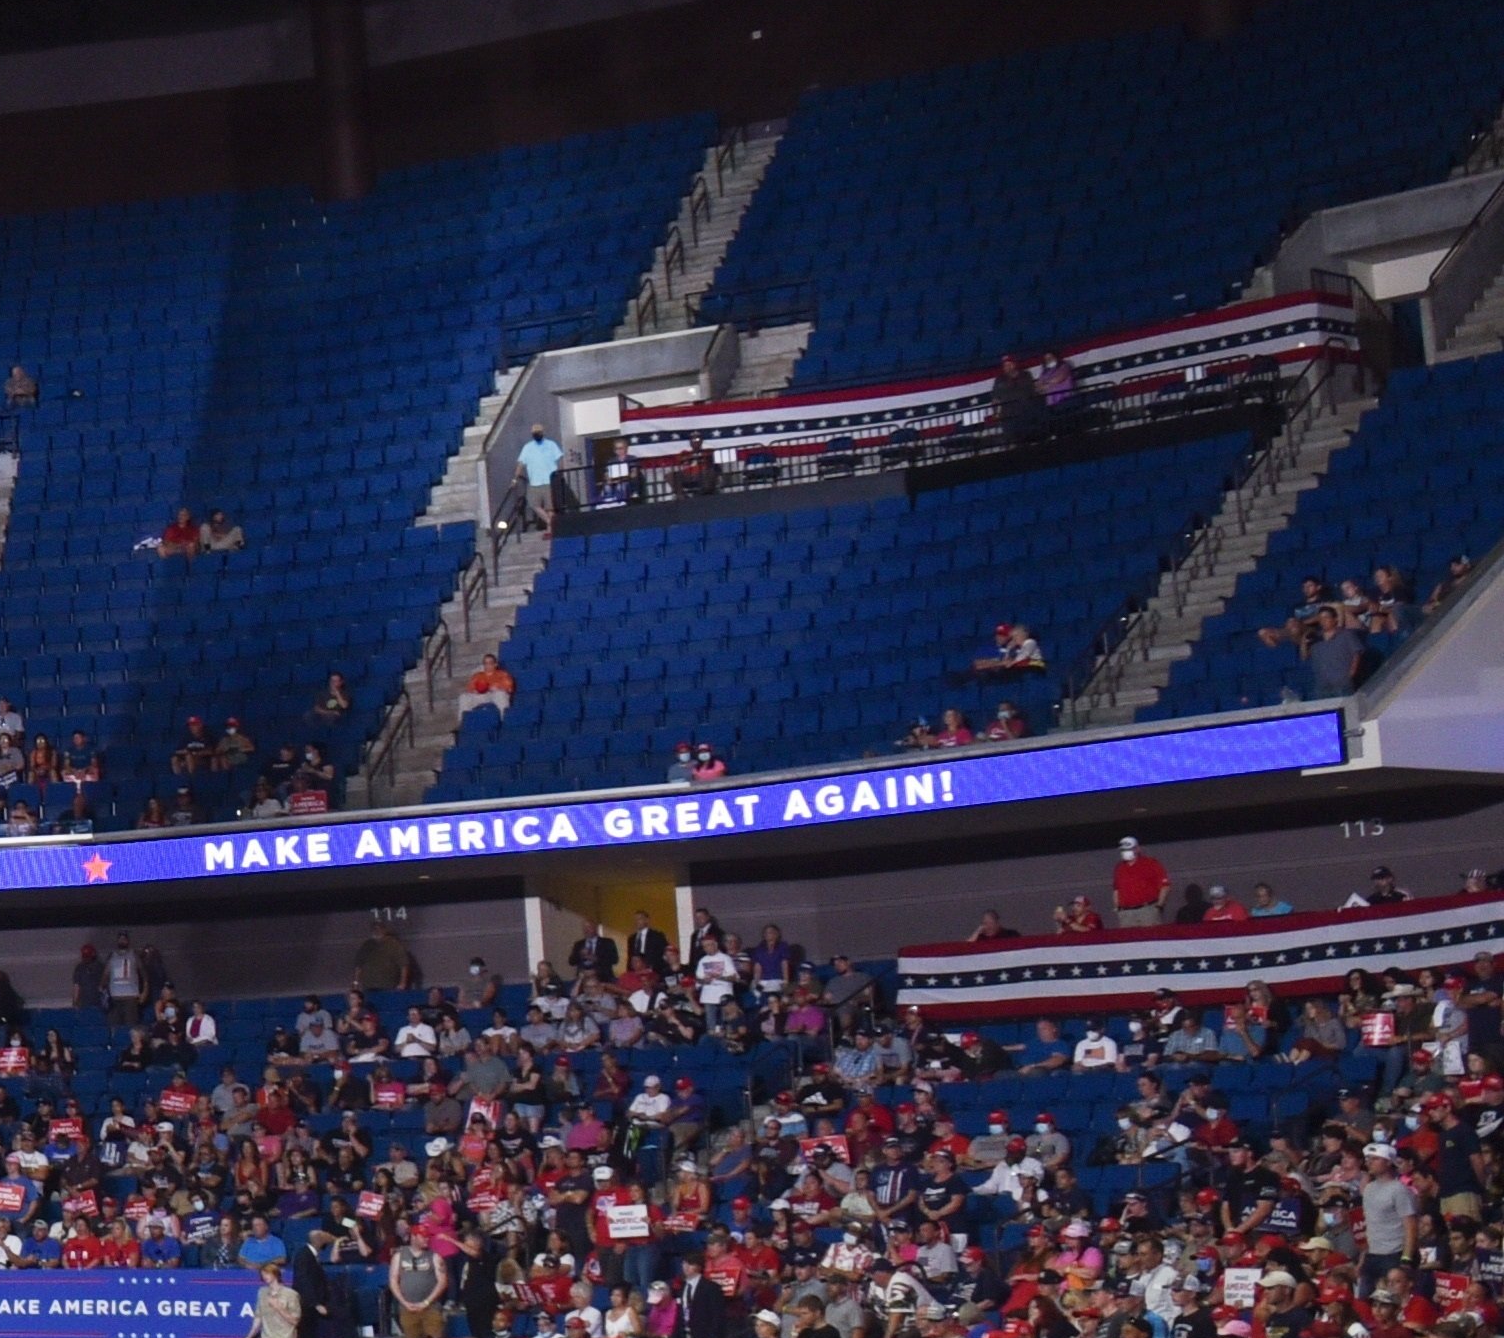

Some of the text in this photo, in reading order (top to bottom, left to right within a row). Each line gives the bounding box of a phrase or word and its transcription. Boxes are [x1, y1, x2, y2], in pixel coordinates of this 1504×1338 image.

[204, 770, 954, 871] MAKE AMERICA GREAT AGAIN!
[1340, 819, 1384, 838] 113
[371, 906, 407, 921] 114
[48, 1299, 149, 1316] AMERICA
[156, 1300, 231, 1318] GREAT
